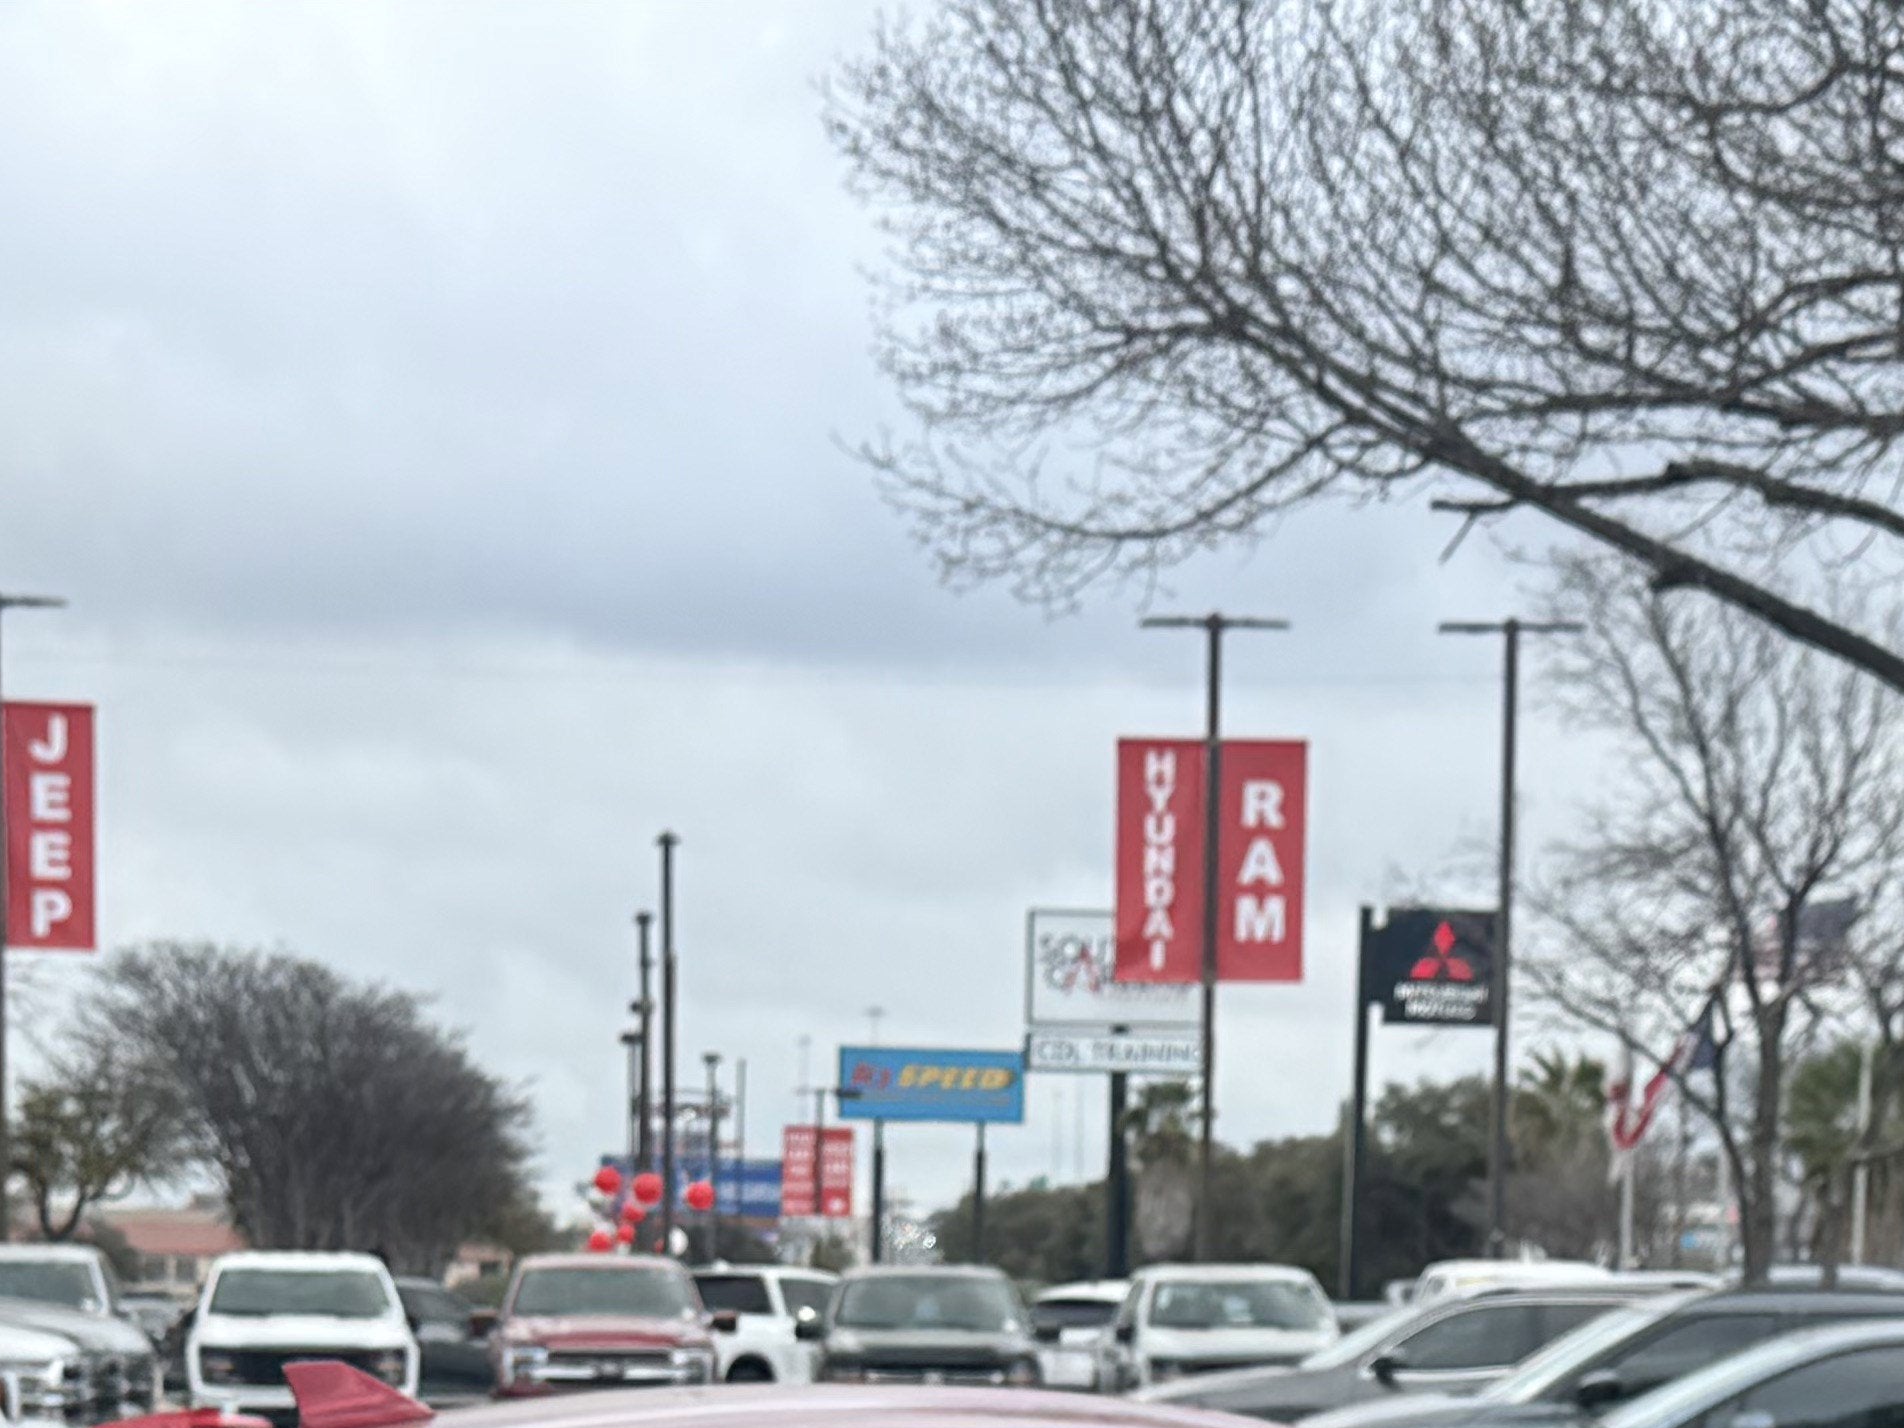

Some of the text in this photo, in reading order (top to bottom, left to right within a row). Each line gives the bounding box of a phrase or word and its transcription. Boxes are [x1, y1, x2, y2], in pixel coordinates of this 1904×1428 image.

[28, 713, 74, 939] JEEP
[1143, 748, 1177, 971] HYUNDAI
[1234, 779, 1286, 943] RAM
